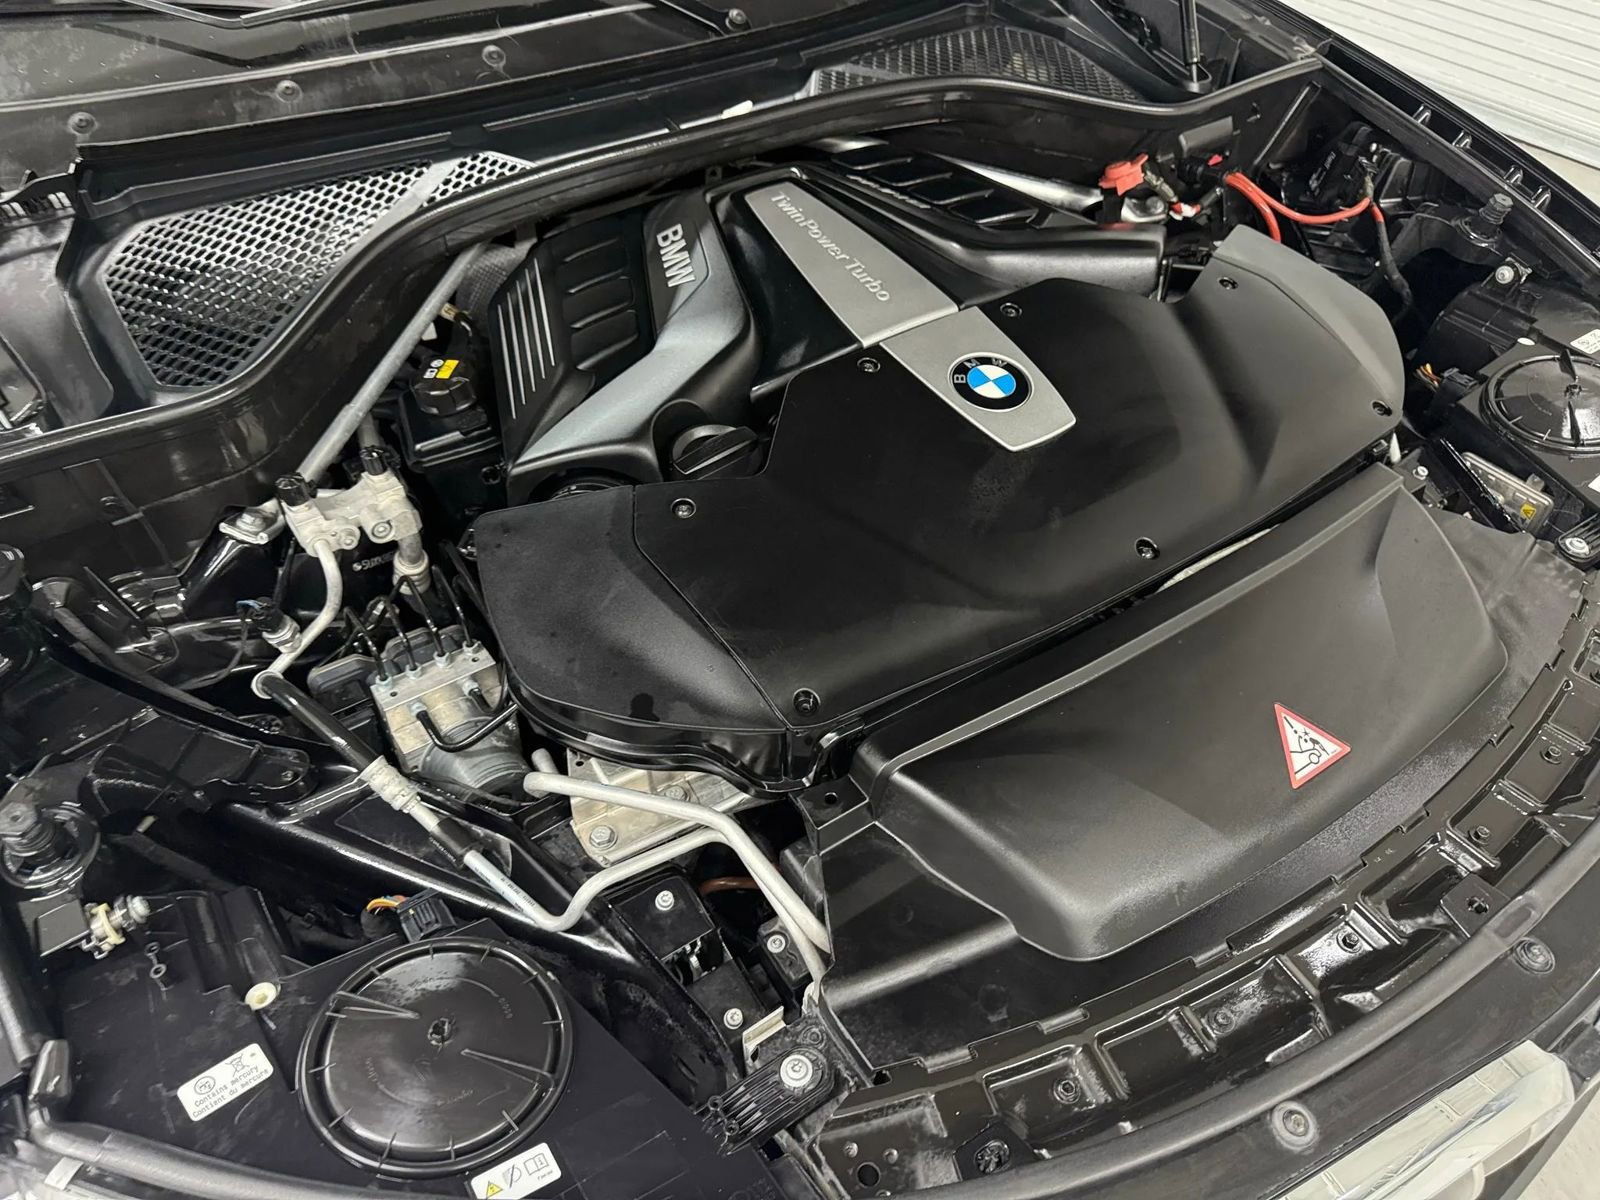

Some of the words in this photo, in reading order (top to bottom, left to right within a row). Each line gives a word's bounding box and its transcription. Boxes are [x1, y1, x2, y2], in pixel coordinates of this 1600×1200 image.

[656, 223, 696, 288] BMW
[770, 192, 849, 260] TwinPower
[845, 257, 890, 302] Turbo
[953, 357, 1008, 384] BMW
[192, 1094, 227, 1118] Contient
[228, 1087, 239, 1096] du
[240, 1069, 269, 1089] mercure
[194, 1084, 228, 1108] Contains
[230, 1065, 259, 1086] mercury
